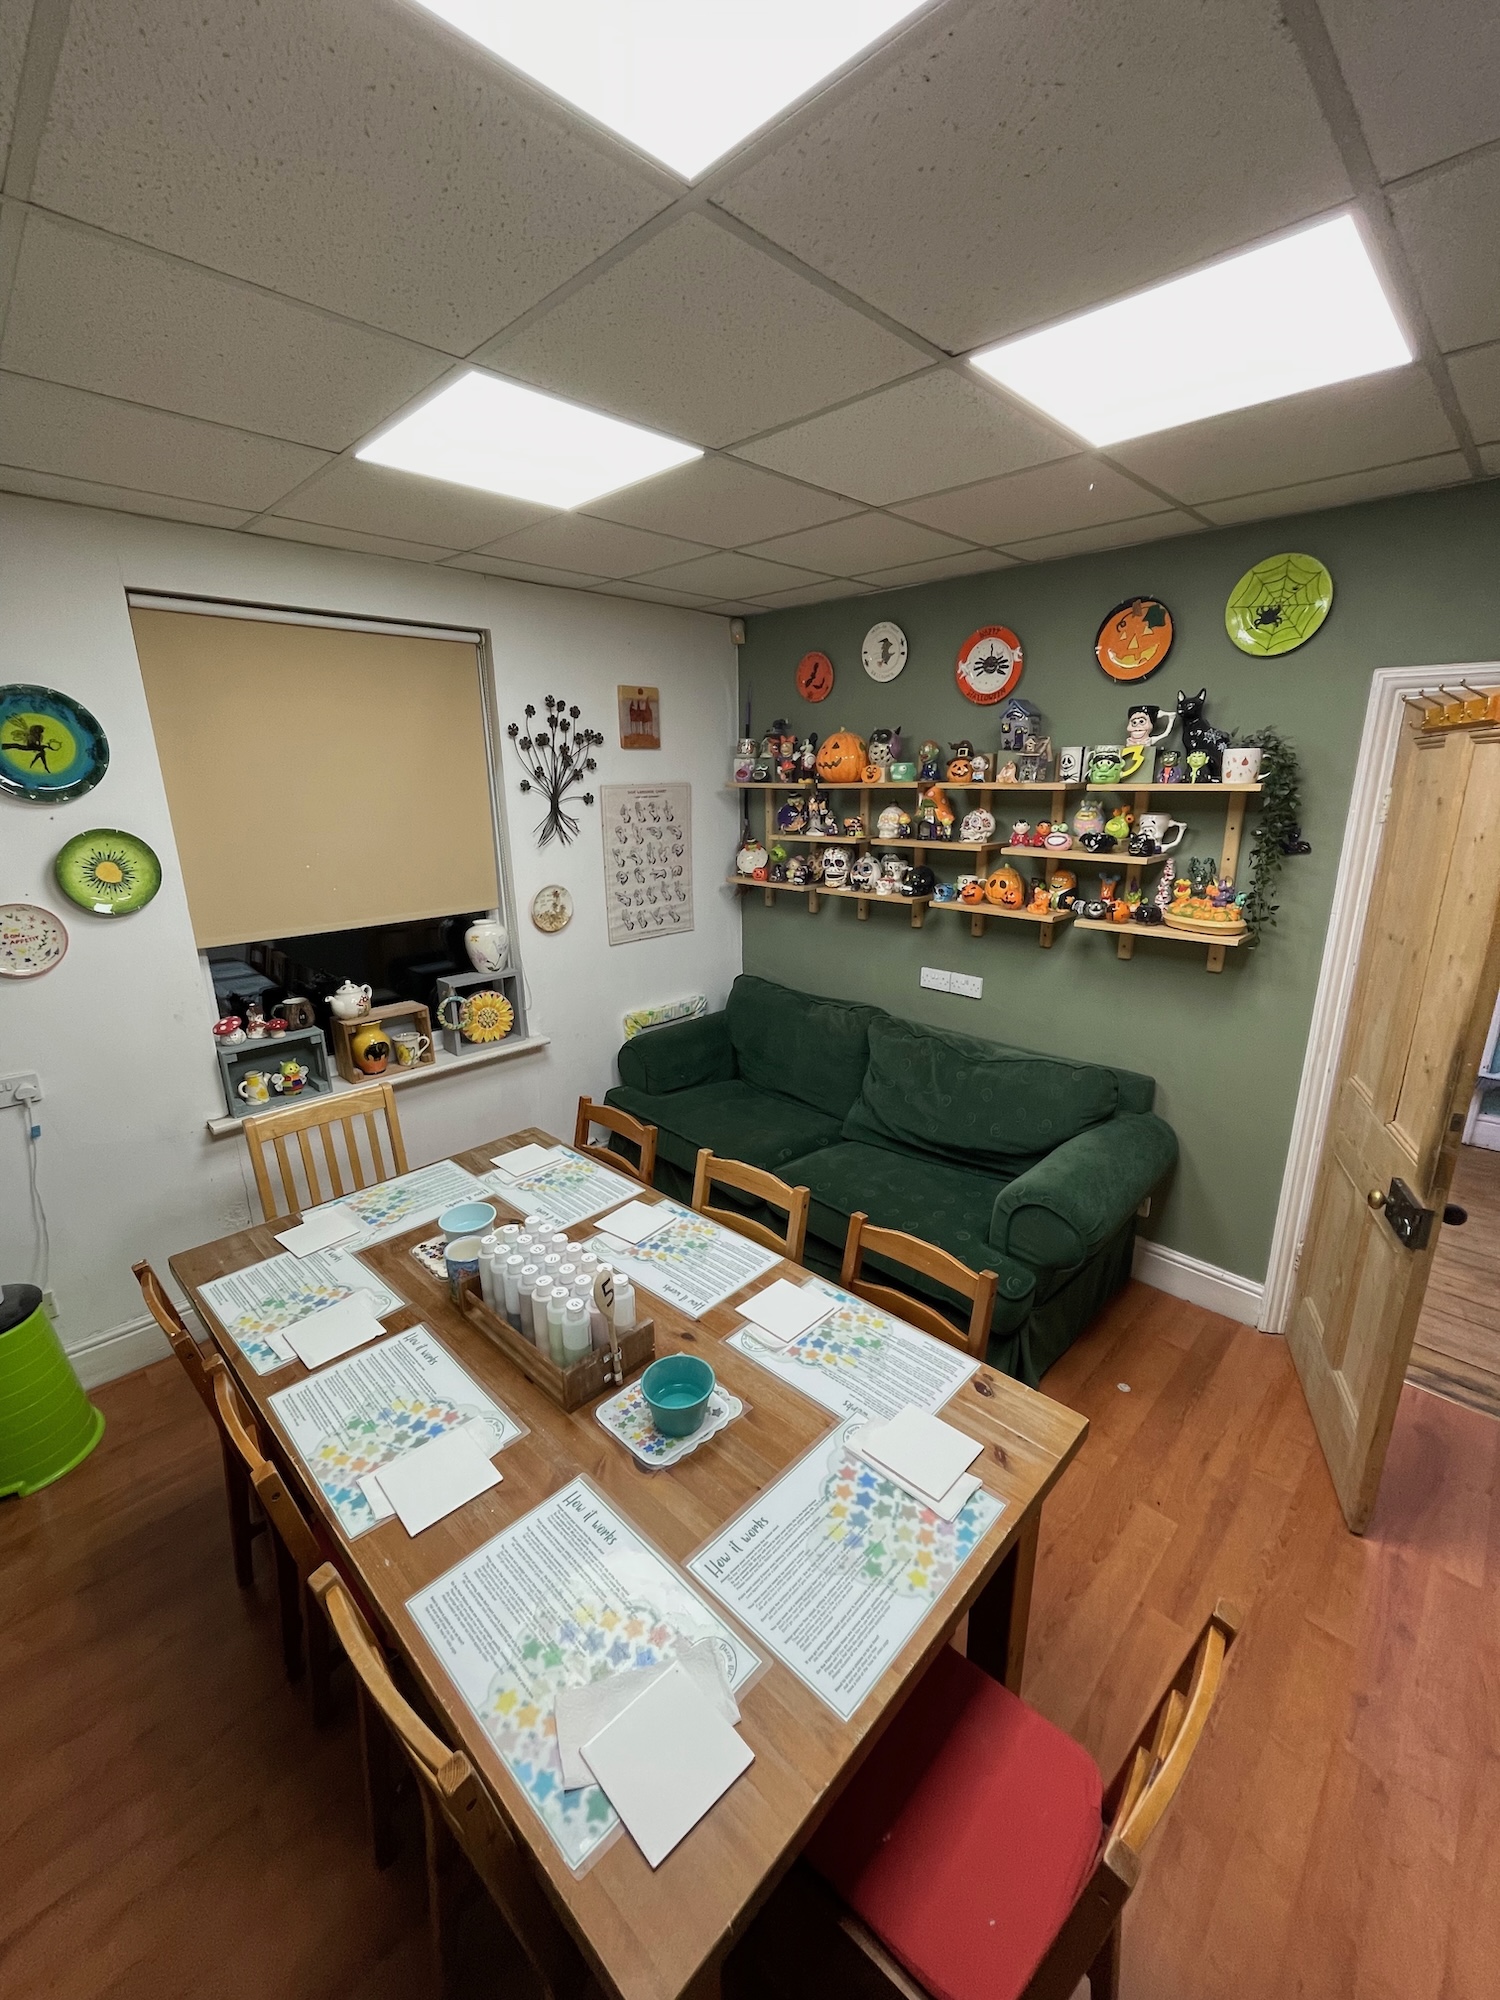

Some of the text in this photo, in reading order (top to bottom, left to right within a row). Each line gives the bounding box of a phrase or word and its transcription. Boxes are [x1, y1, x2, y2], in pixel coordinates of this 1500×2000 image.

[9, 935, 39, 946] APPETIT
[601, 1277, 615, 1307] 5
[402, 1331, 420, 1345] How
[420, 1348, 438, 1365] works
[561, 1490, 619, 1547] How it works
[704, 1515, 769, 1578] How it works
